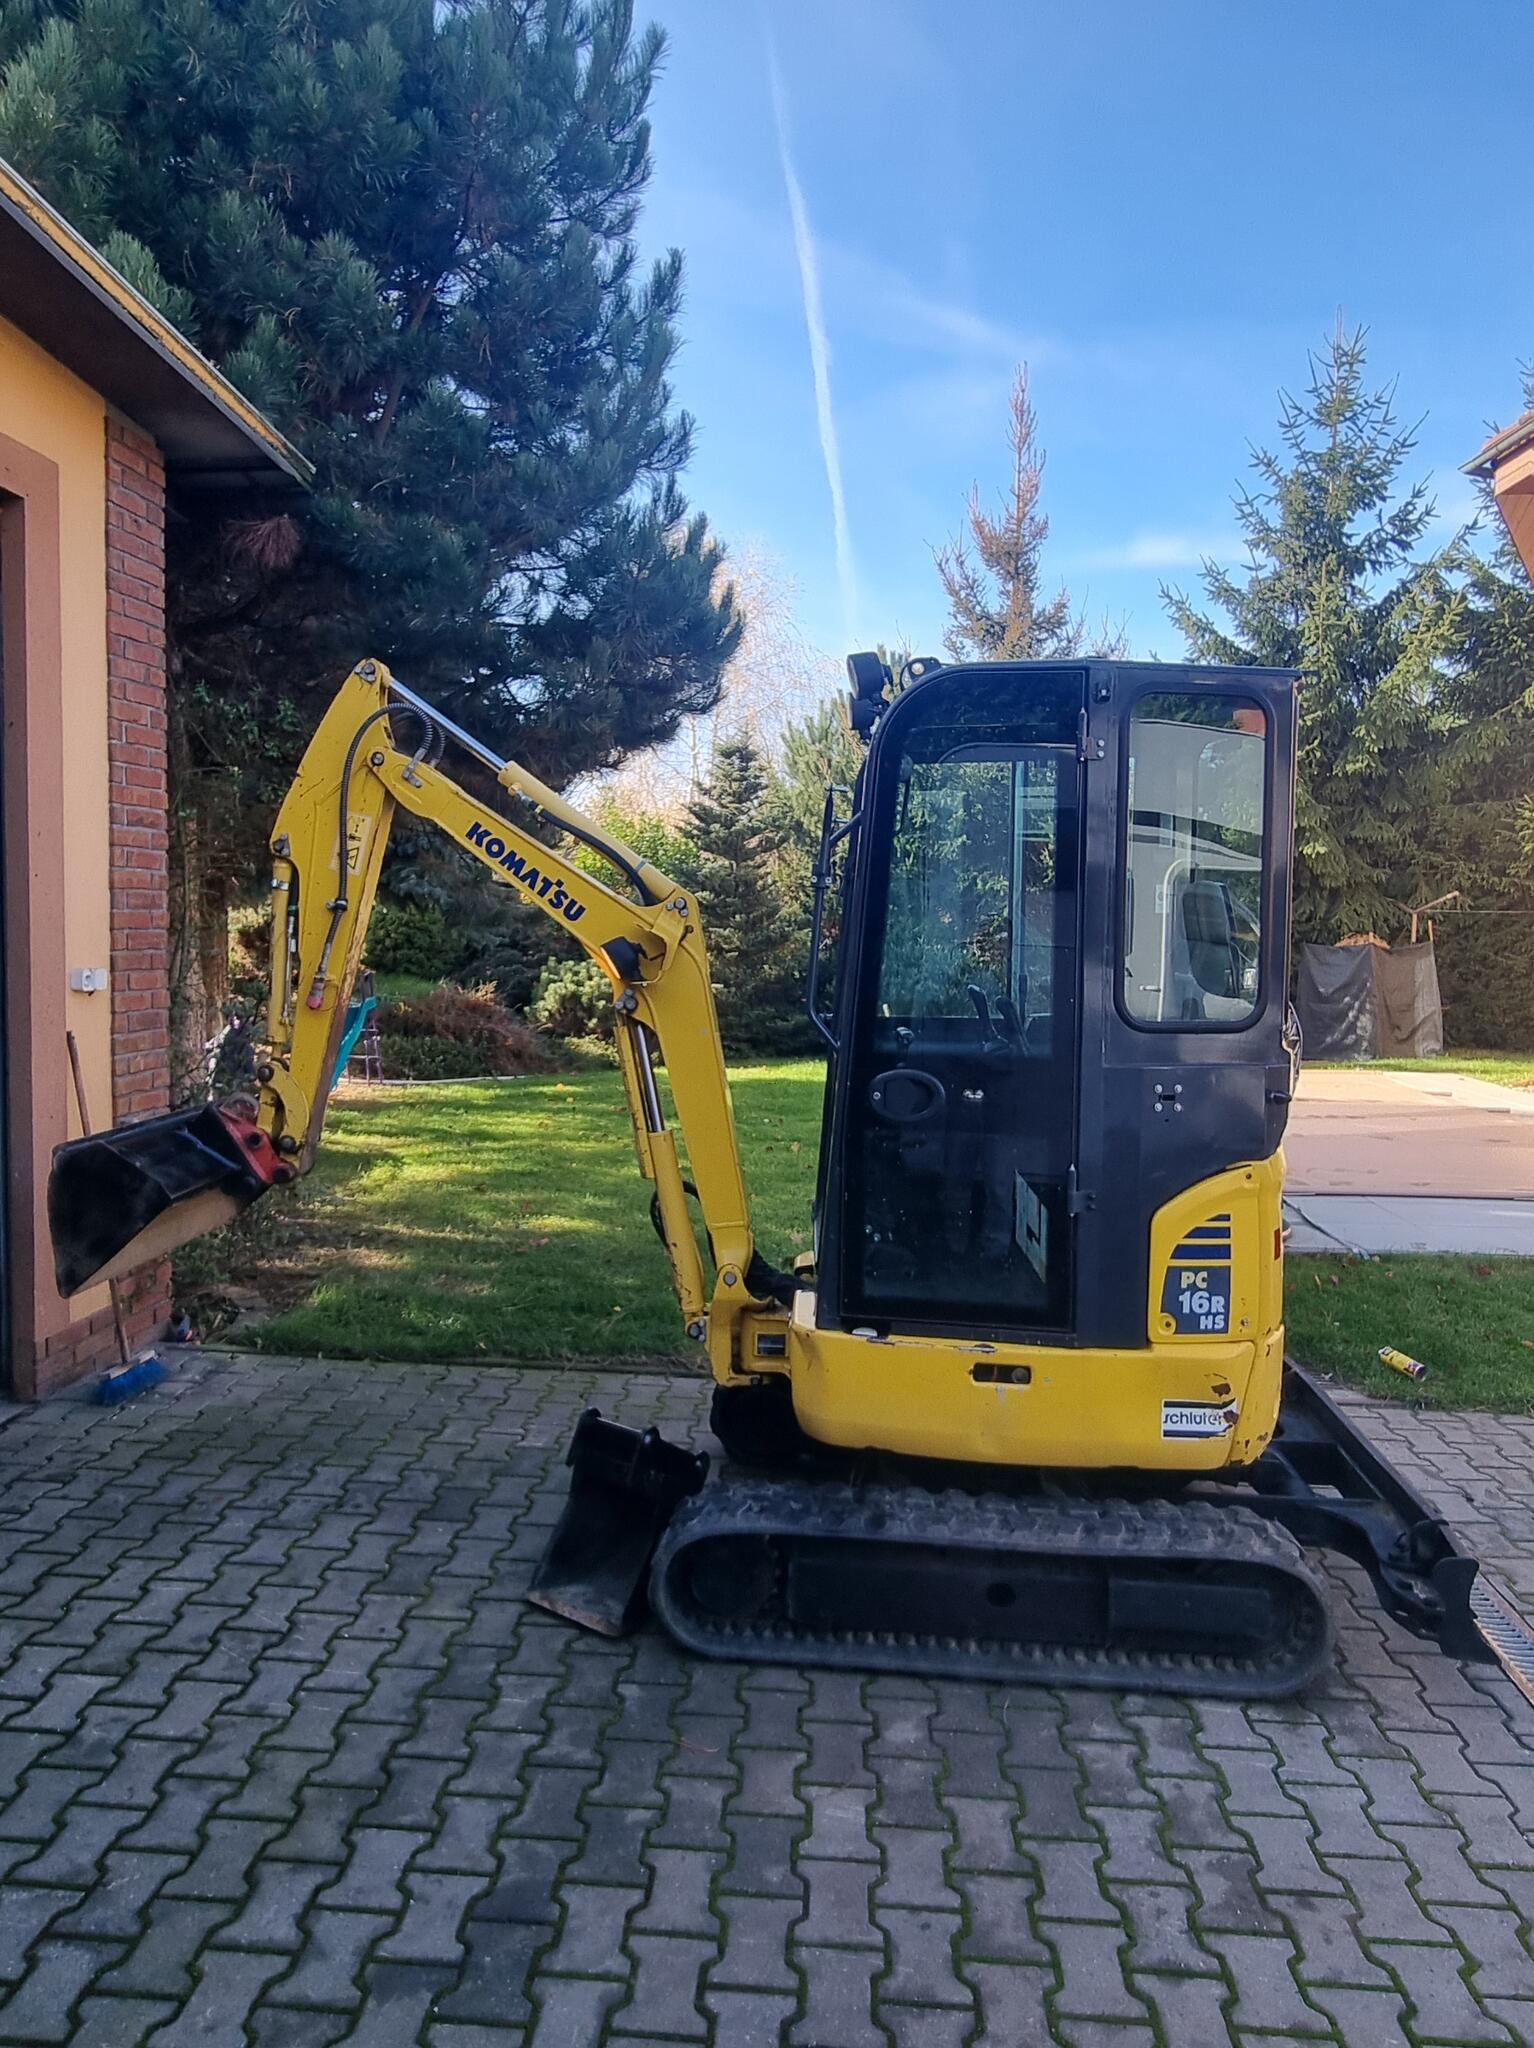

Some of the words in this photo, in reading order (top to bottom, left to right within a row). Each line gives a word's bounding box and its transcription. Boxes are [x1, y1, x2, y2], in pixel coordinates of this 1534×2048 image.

[465, 821, 586, 922] KOMATSU
[1180, 1271, 1208, 1289] PC
[1178, 1290, 1225, 1314] 16R
[1199, 1315, 1225, 1330] HS
